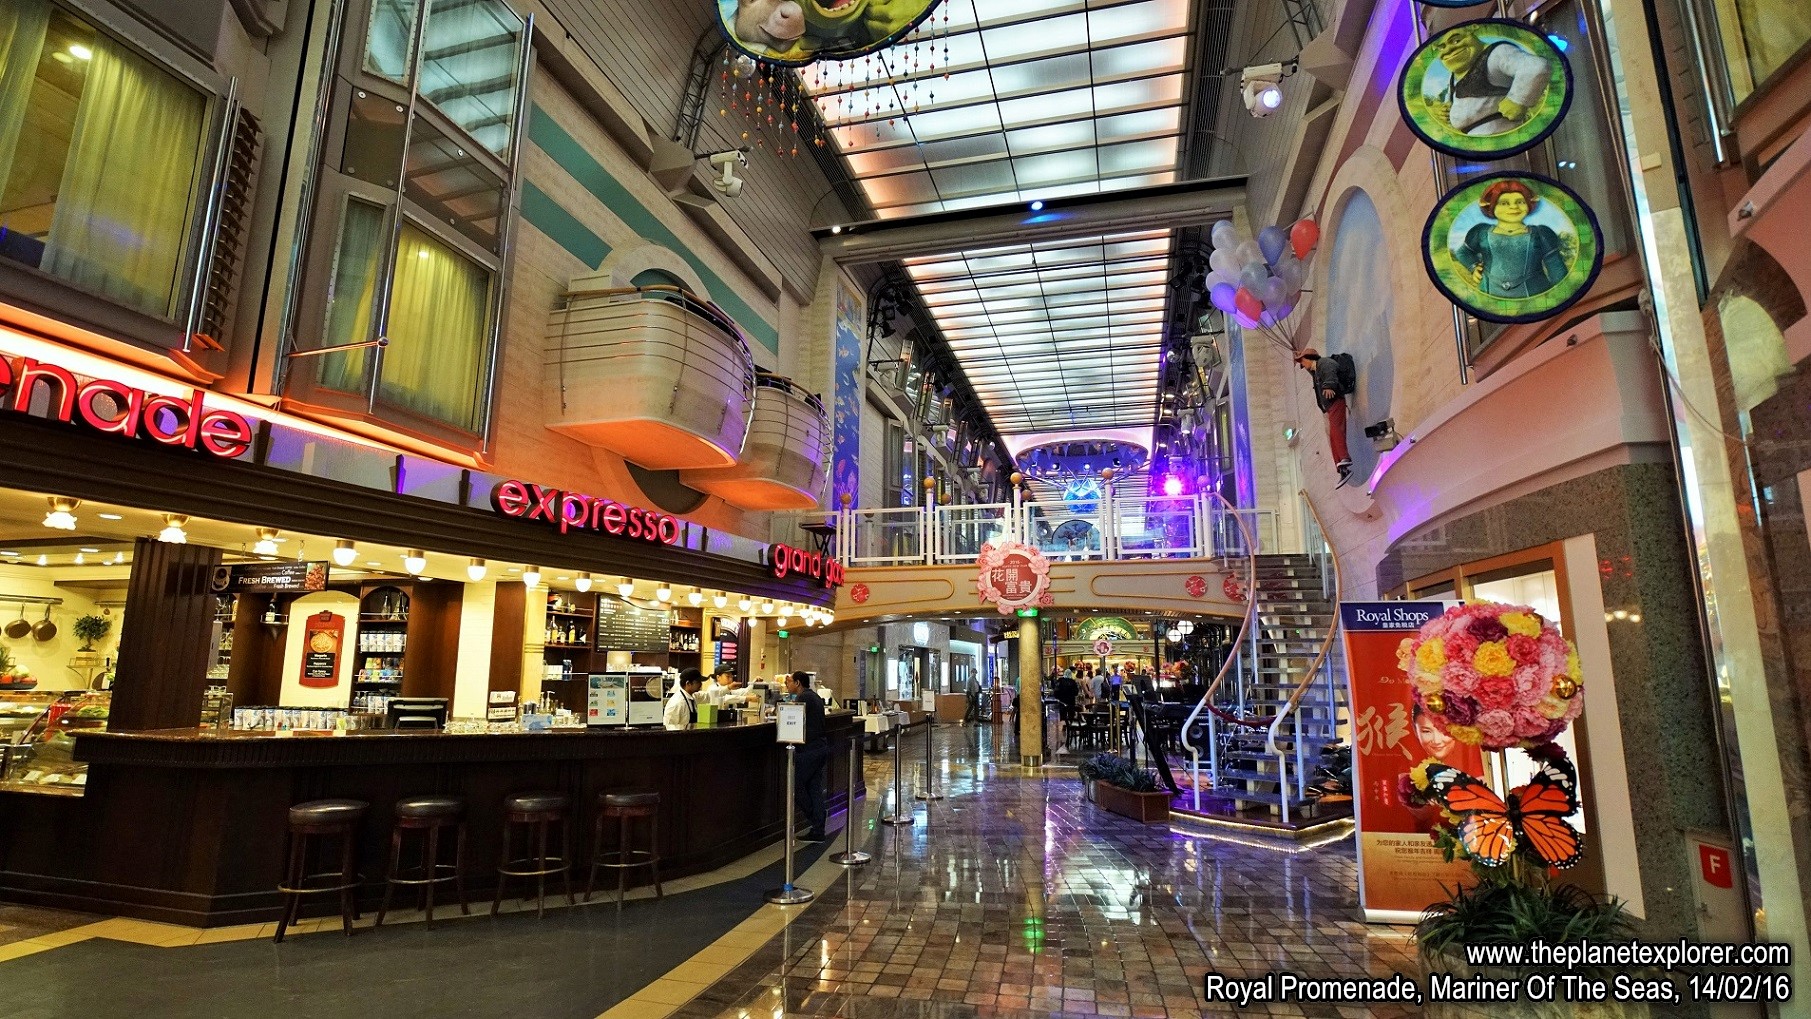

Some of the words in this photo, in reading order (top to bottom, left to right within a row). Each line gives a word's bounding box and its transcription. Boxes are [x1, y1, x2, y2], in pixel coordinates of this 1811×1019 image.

[0, 354, 252, 458] nade
[497, 479, 680, 545] expresso
[773, 542, 821, 579] grand
[237, 576, 260, 585] FRESH
[261, 575, 292, 584] BREWED
[1355, 608, 1391, 625] Royal
[1394, 608, 1429, 625] Shops
[1709, 854, 1721, 874] F
